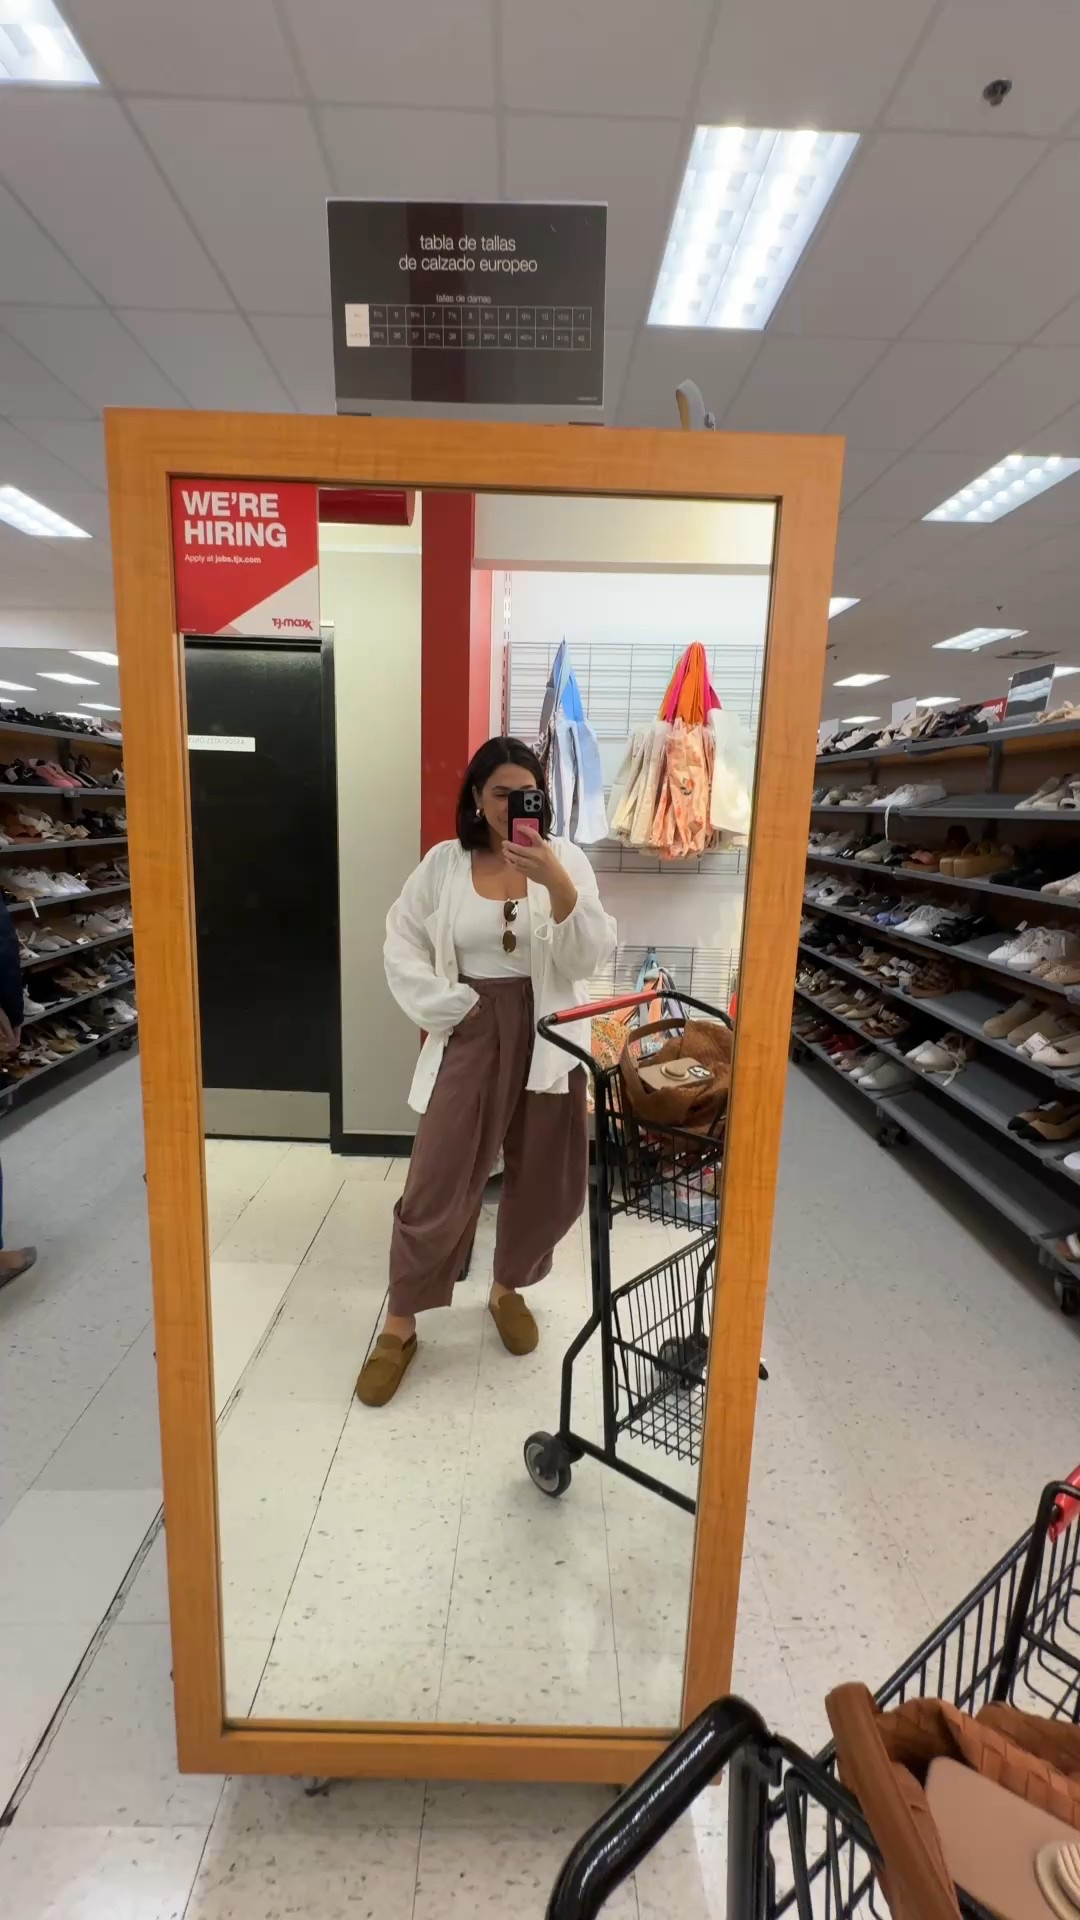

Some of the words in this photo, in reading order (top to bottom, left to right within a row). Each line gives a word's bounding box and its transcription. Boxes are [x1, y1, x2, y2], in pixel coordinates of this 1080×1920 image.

[420, 234, 454, 251] tabla
[458, 234, 477, 251] de
[481, 235, 516, 252] tallas
[398, 254, 417, 271] de
[421, 255, 475, 272] calzado
[480, 258, 538, 274] europeo
[436, 293, 454, 303] tallas
[456, 294, 466, 303] de
[467, 295, 492, 304] damas
[182, 490, 279, 518] WE’RE
[184, 520, 287, 548] HIRING
[184, 554, 205, 564] Apply
[206, 554, 213, 562] at
[215, 555, 262, 565] jobs.tjx.com
